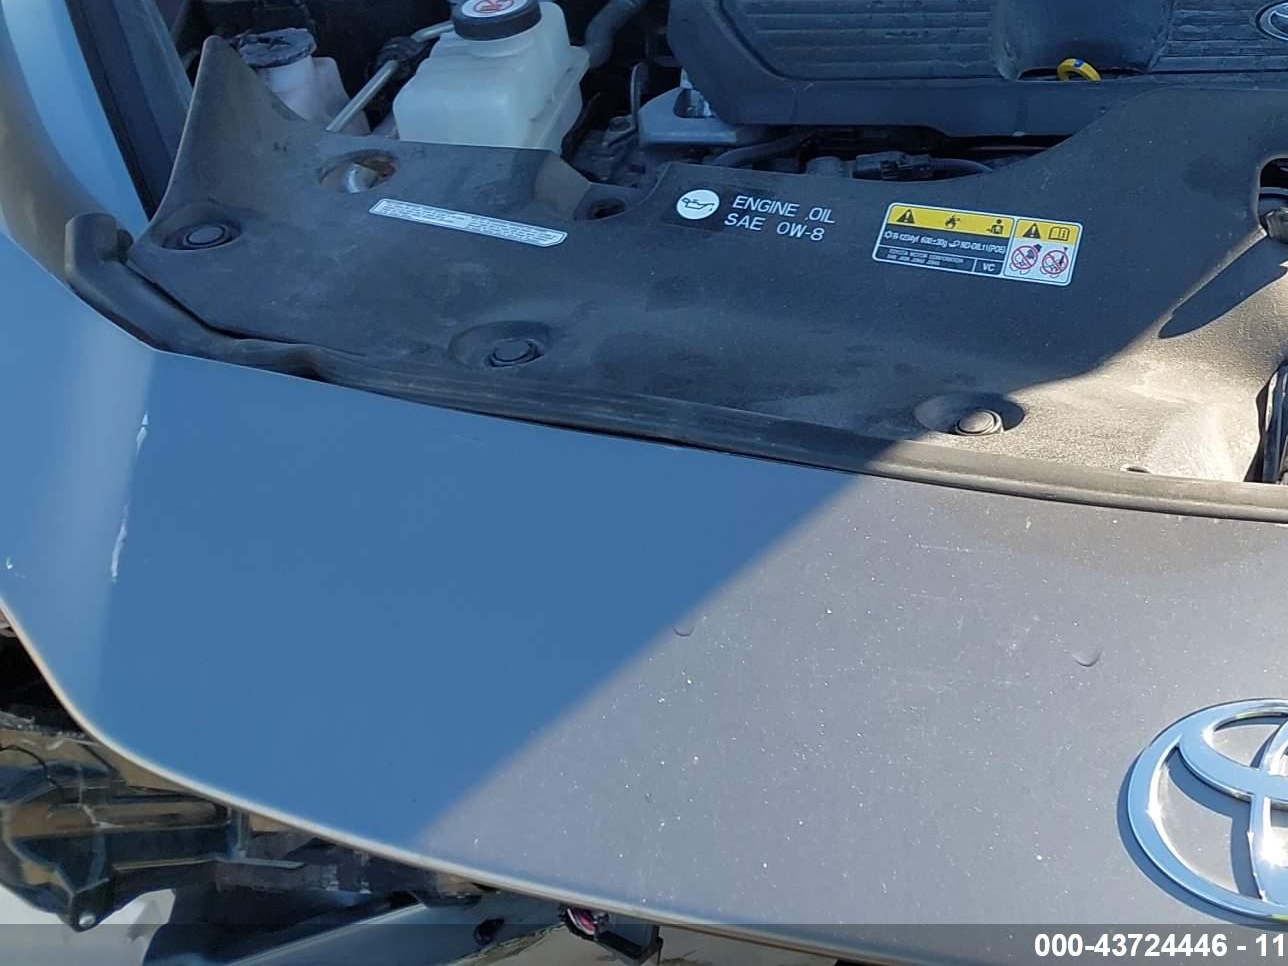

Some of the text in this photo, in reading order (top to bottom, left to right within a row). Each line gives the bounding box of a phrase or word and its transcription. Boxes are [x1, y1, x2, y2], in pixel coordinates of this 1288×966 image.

[732, 195, 836, 224] ENGINE OIL
[724, 213, 825, 241] SAE 0W-8
[983, 262, 996, 272] VC
